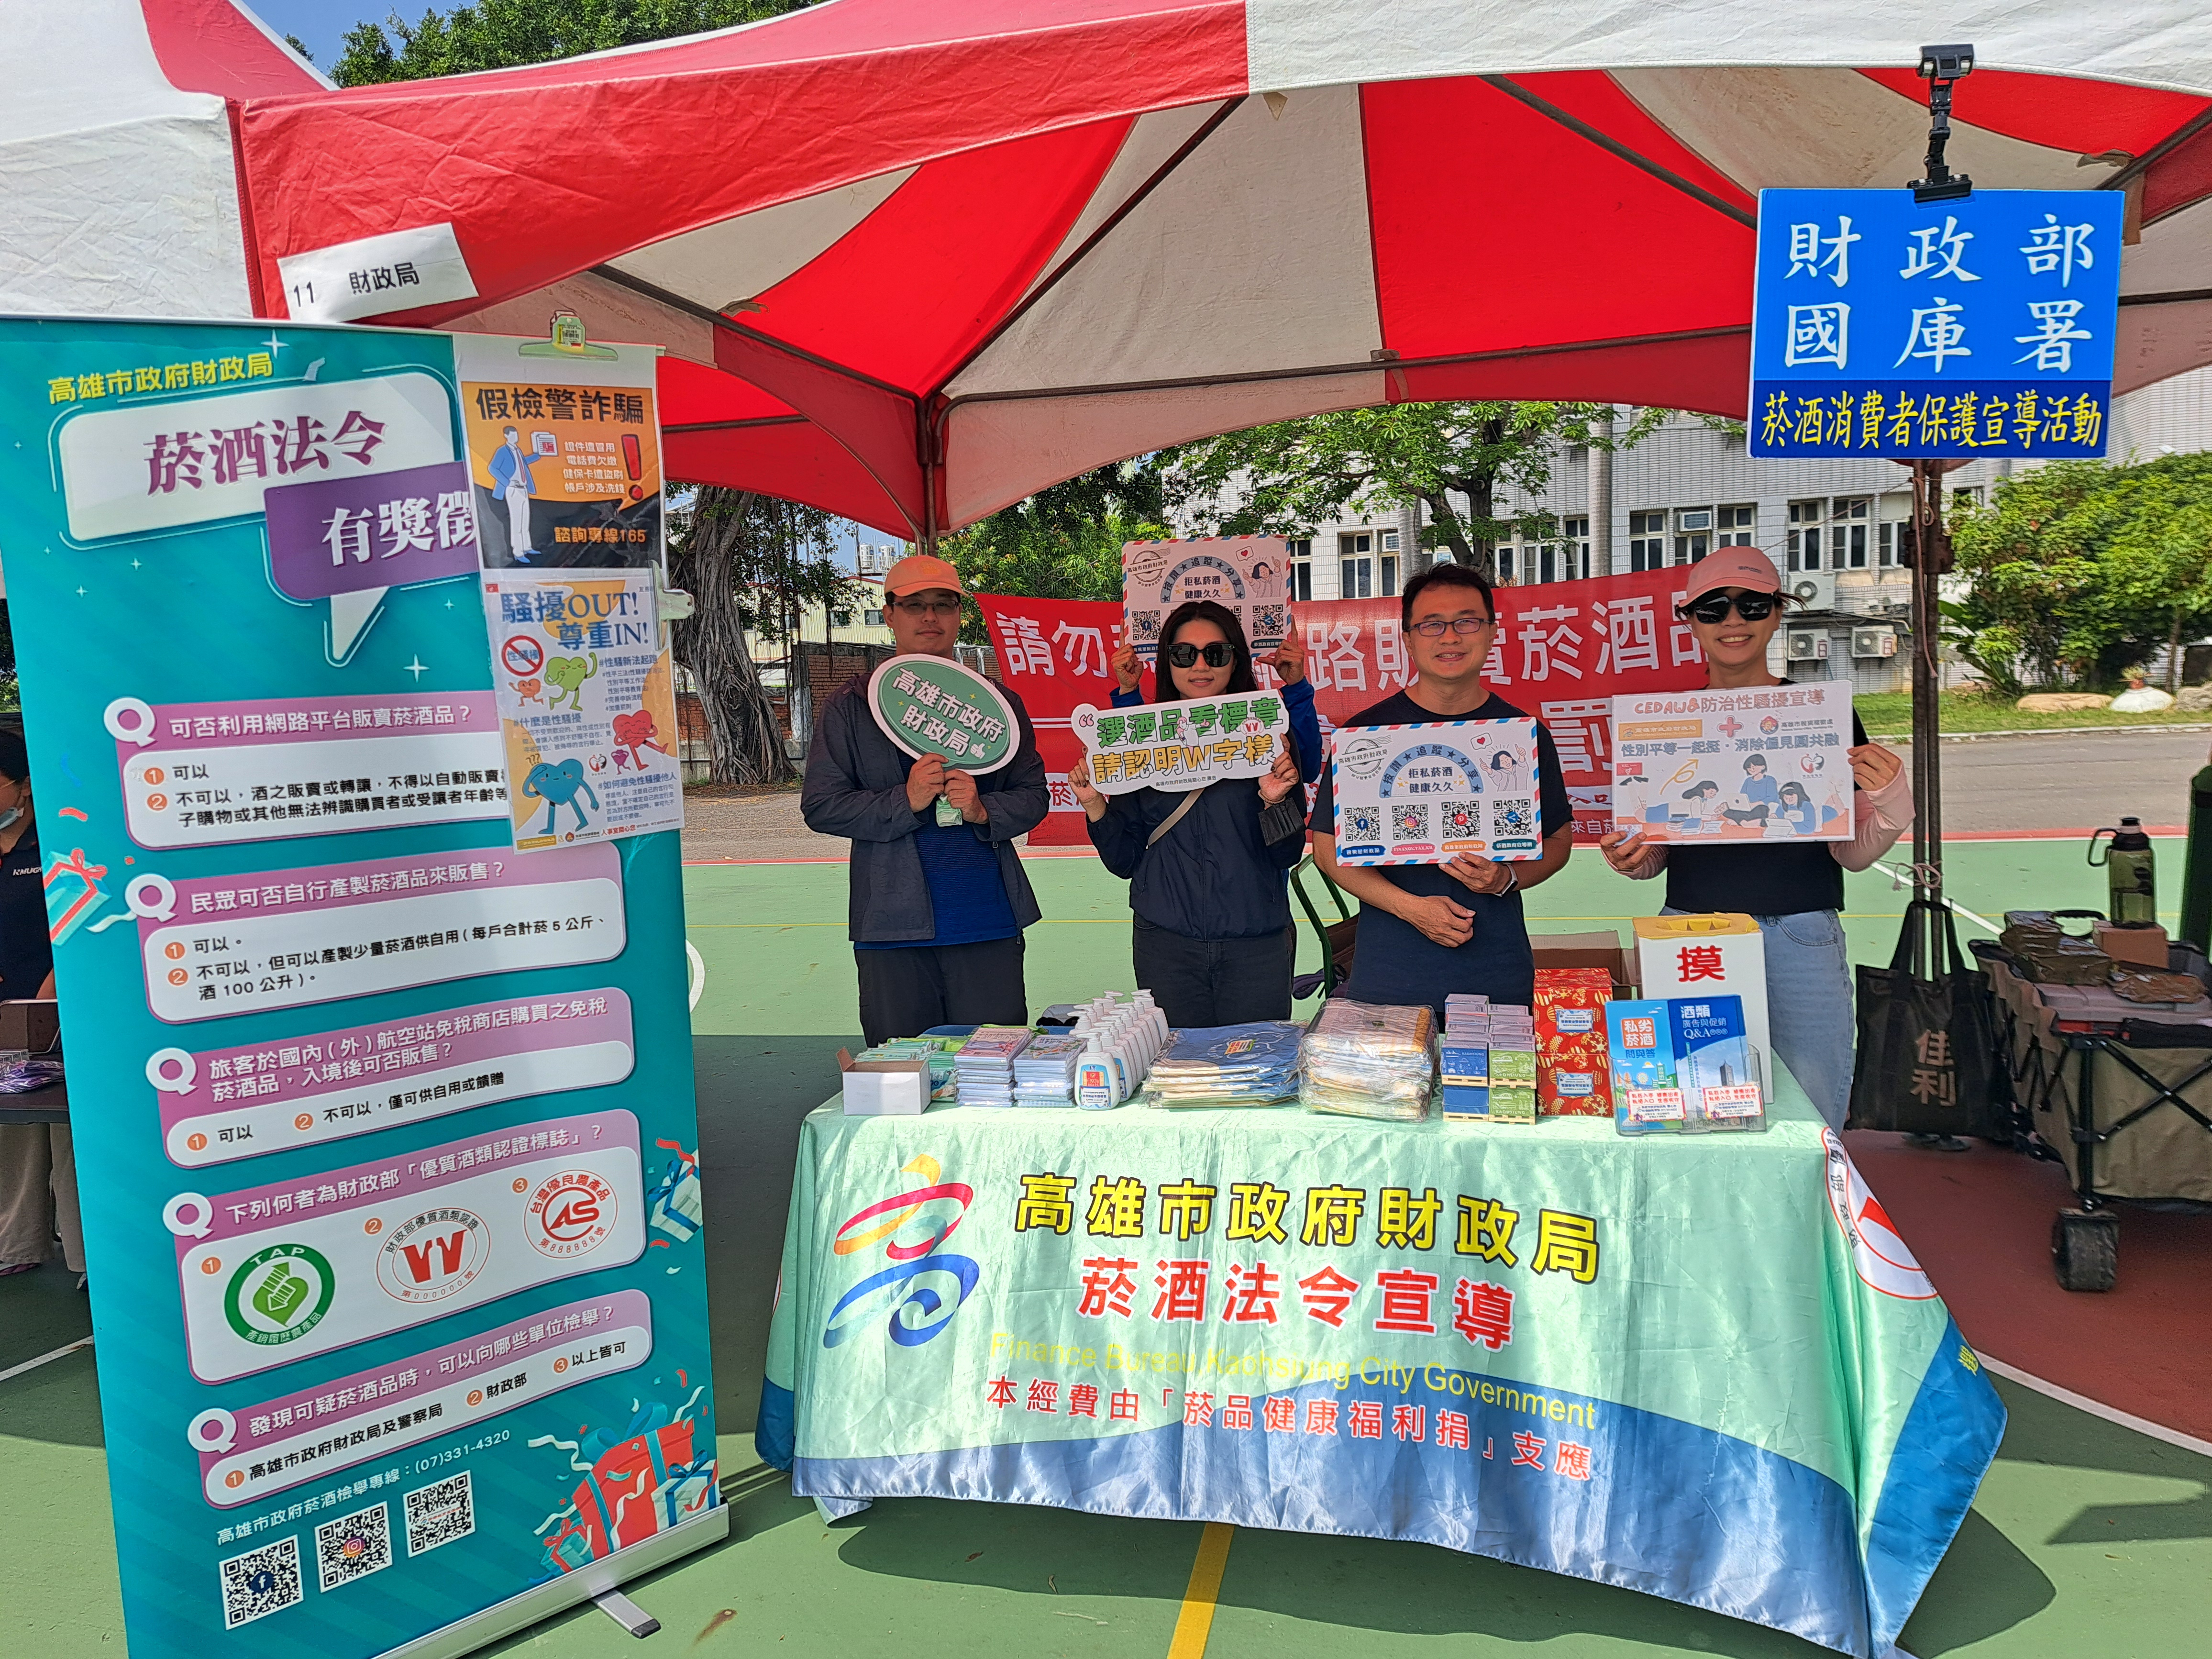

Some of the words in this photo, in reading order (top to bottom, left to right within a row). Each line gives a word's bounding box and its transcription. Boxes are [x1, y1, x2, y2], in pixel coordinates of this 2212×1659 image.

[1783, 213, 2096, 288] 財政部
[293, 281, 316, 307] 11
[348, 262, 420, 294] 財政局
[1784, 297, 2093, 373] 國庫署
[48, 353, 273, 404] 高雄市政府財政局
[476, 388, 644, 424] 假檢警詐騙
[1760, 389, 2102, 449] 菸酒消費者保護宣導活動
[144, 410, 387, 496] 菸酒法令
[1184, 588, 1221, 599] 健康久久
[104, 697, 156, 746] Q
[892, 667, 1006, 742] 高雄市政府
[1097, 697, 1283, 748] 選酒品看標章
[900, 704, 971, 756] 財政局
[173, 764, 209, 781] 可以
[1092, 734, 1276, 784] 請認明W字樣
[1409, 766, 1453, 778] 拒私菸酒
[176, 769, 505, 807] 不可以，酒之販賣或轉讓，不得以自動販賣
[1409, 782, 1453, 793] 健康久久
[124, 873, 177, 922] Q
[189, 861, 505, 916] 民眾可否自行產製菸酒品來販售？
[1676, 945, 1726, 983] 摸
[1624, 1019, 1652, 1032] 私劣
[1681, 1005, 1710, 1019] 酒類
[1683, 1028, 1711, 1039] Q&A
[1626, 1033, 1653, 1047] 菸酒
[1626, 1049, 1656, 1059] 問與答
[145, 1048, 198, 1096] Q
[1910, 1029, 1958, 1107] 佳利
[217, 1125, 254, 1142] 可以
[162, 1192, 215, 1238] Q
[530, 1174, 610, 1214] 台灣優良農產品
[385, 1210, 479, 1254] 財政部優質酒類認證
[1014, 1171, 1600, 1284] 高雄市政府財政局
[249, 1247, 305, 1265] TAP
[245, 1312, 322, 1344] 產銷履歷農產品
[1078, 1256, 1515, 1353] 菸酒法令宣導
[990, 1332, 1096, 1367] Finance
[1360, 1356, 1415, 1394] City
[1425, 1362, 1595, 1430] Government
[188, 1407, 238, 1455] Q
[248, 1402, 443, 1482] 高雄市政府財政局及警察局
[485, 1371, 528, 1401] 財政部
[570, 1339, 627, 1368] 以上皆可
